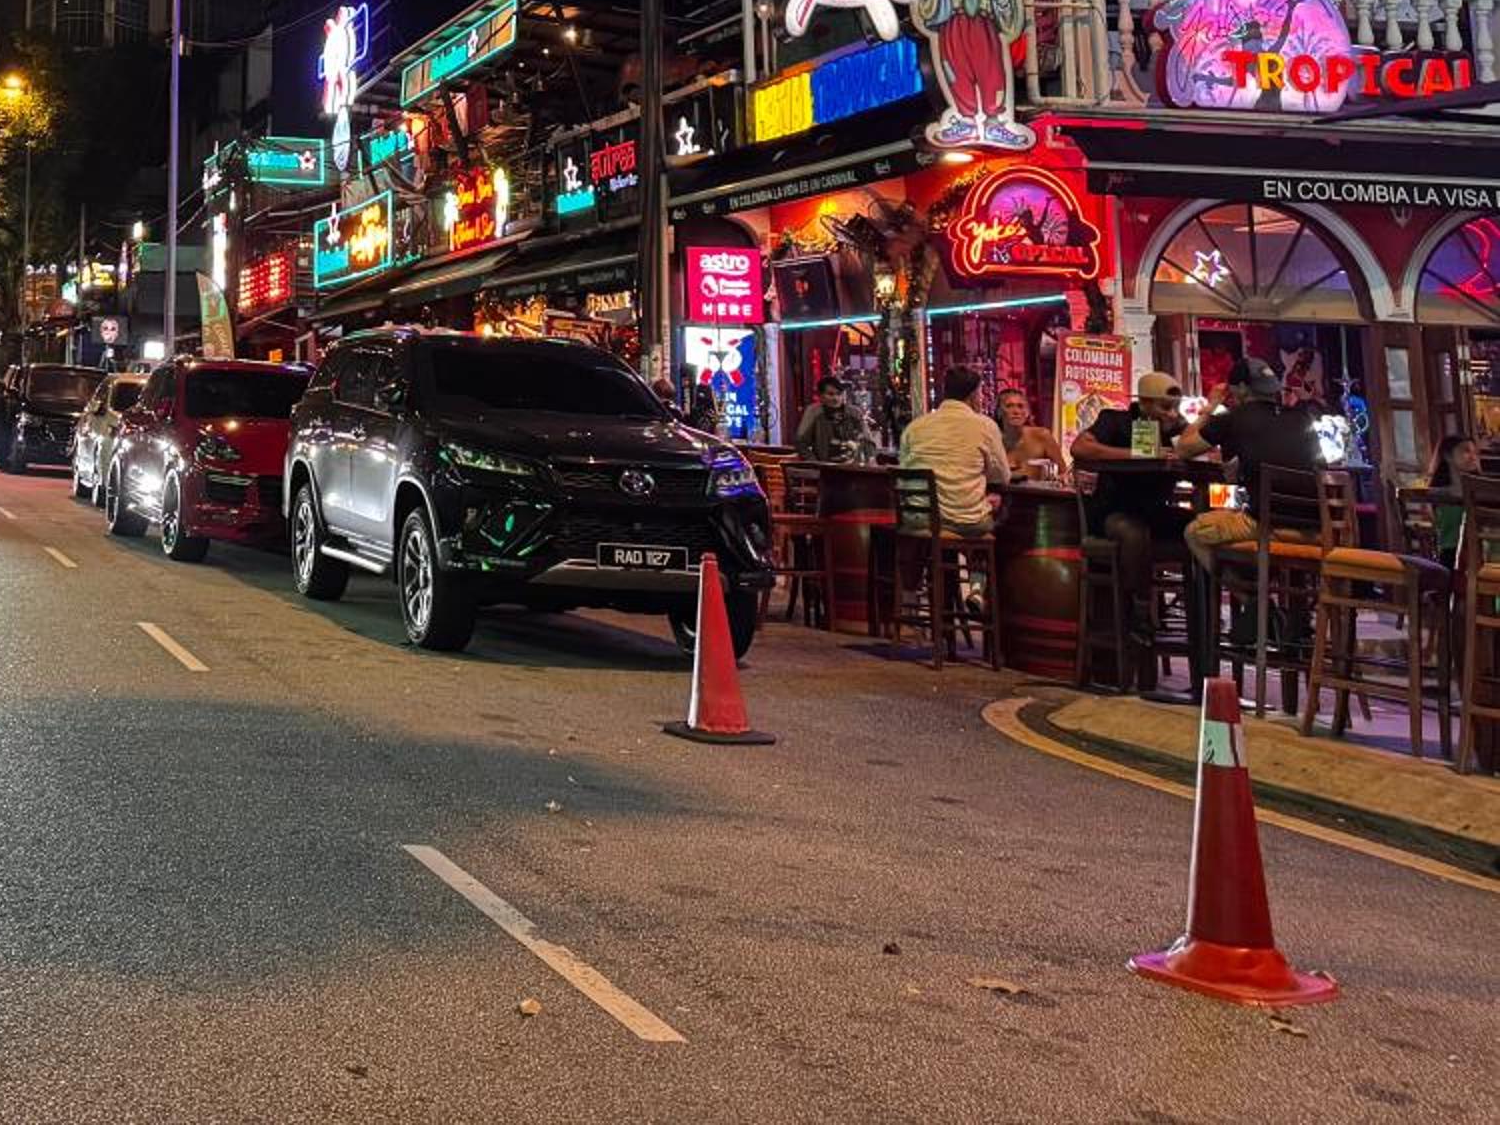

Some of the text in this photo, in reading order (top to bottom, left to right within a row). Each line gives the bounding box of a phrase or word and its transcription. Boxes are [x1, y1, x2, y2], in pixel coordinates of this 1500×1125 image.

[1263, 180, 1492, 209] EN COLOMBIA LA VISA
[700, 253, 750, 273] astro
[702, 303, 753, 316] HERE
[1064, 348, 1124, 367] COLOMBIAN
[1065, 364, 1124, 383] ROTISSERIE
[614, 548, 643, 565] RAD
